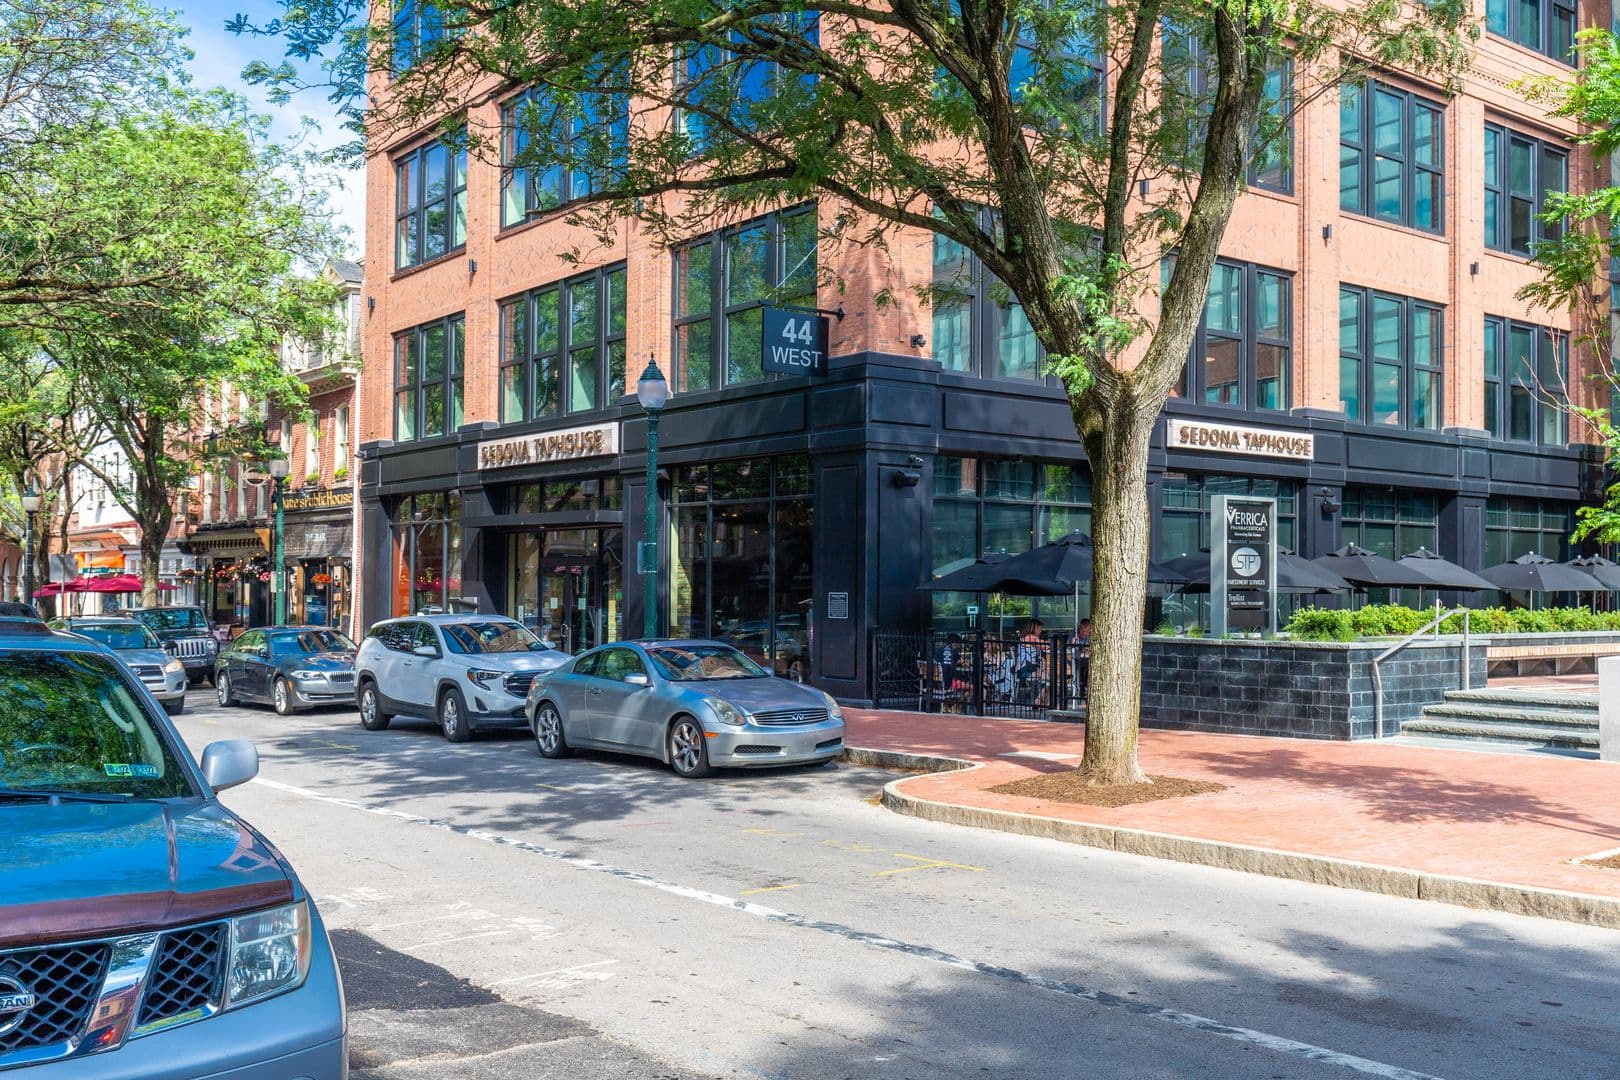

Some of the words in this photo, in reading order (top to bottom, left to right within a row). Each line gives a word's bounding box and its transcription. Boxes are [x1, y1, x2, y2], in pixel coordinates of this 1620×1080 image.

[782, 318, 813, 345] 44
[772, 345, 822, 368] WEST
[481, 440, 531, 464] SEDONA
[533, 429, 603, 460] TAPHOUSE
[1179, 425, 1240, 449] SEDONA
[1243, 431, 1312, 456] TAPHOUSE
[327, 489, 353, 506] House
[1227, 506, 1268, 526] VERRICA
